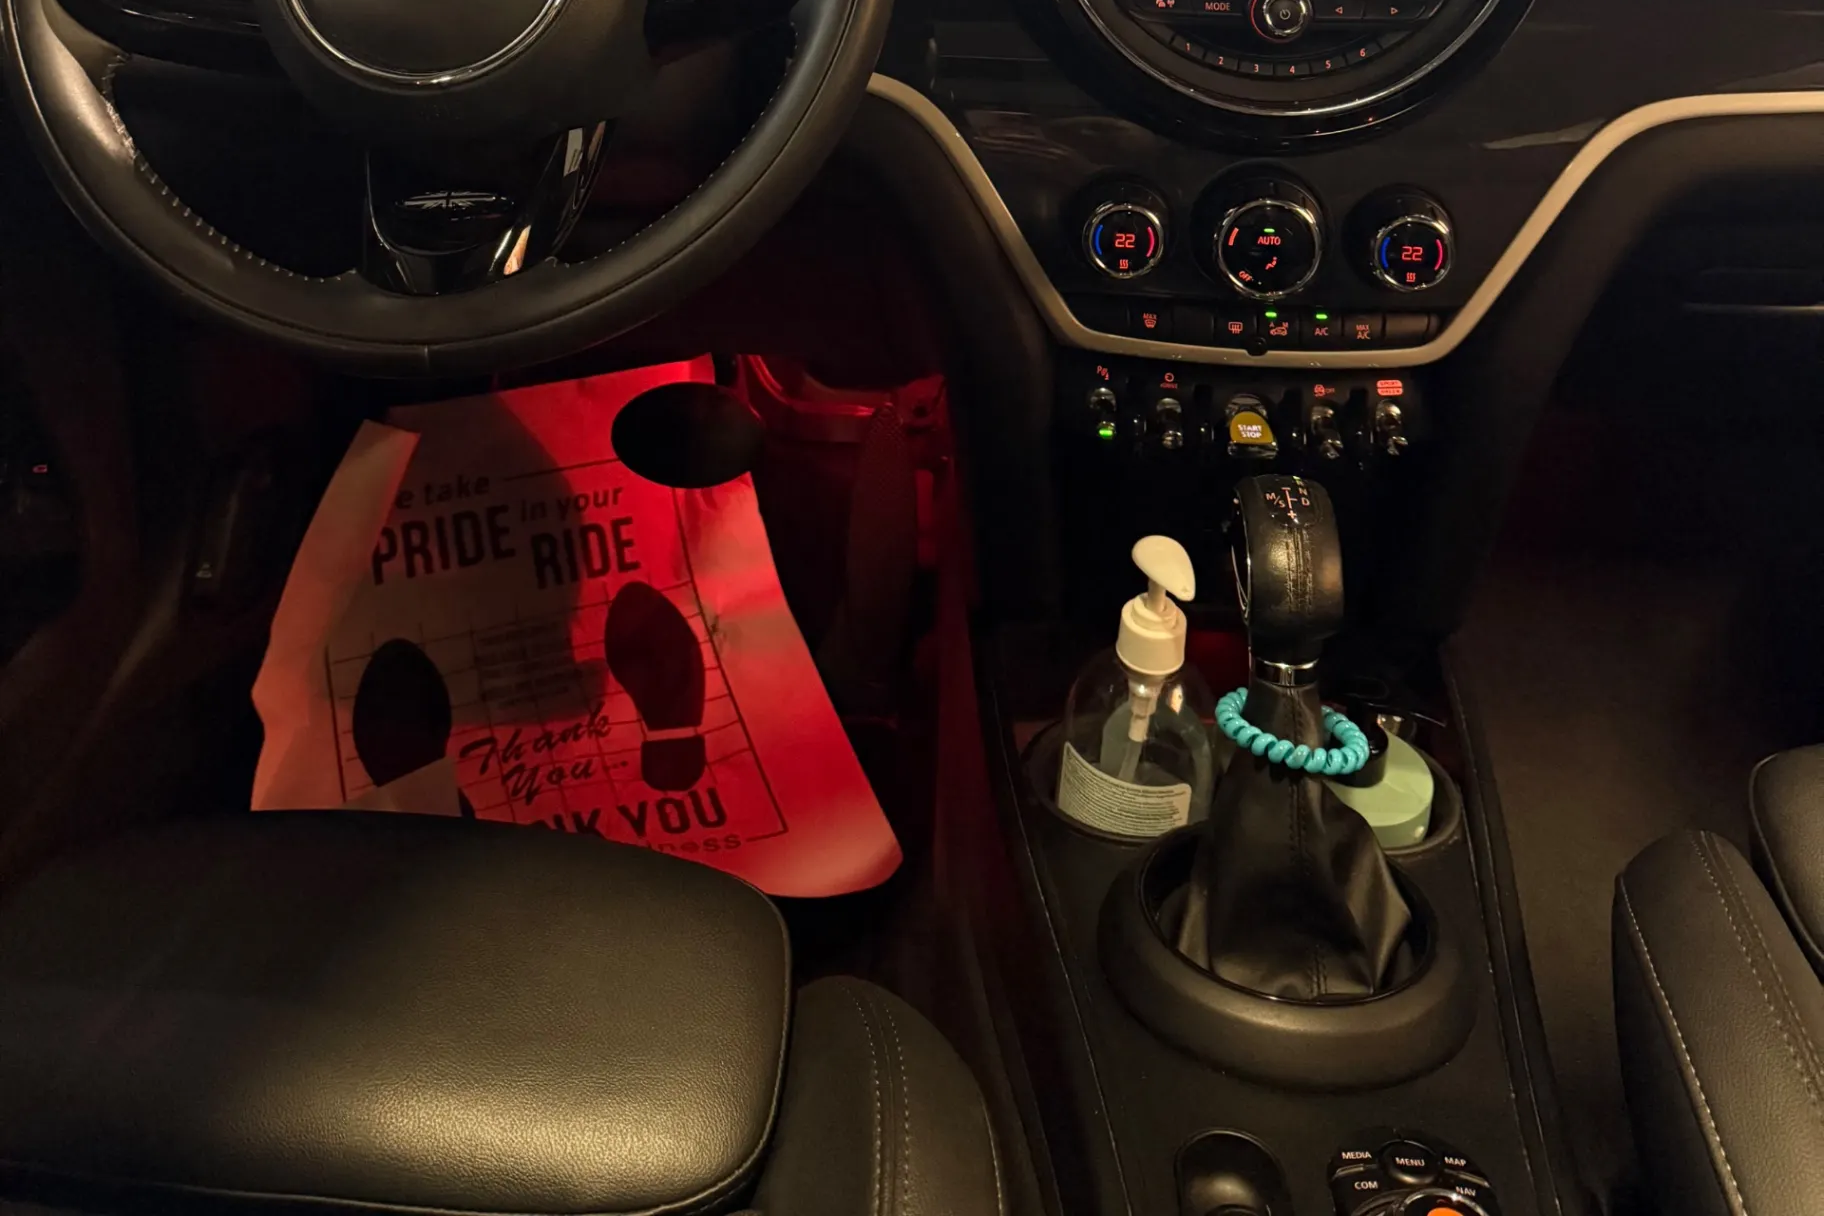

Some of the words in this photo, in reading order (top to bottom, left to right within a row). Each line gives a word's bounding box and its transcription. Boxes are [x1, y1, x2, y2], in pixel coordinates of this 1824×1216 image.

[1205, 2, 1230, 11] MODE
[1186, 43, 1190, 51] 1
[1360, 48, 1366, 57] 6
[1218, 56, 1224, 65] 2
[1325, 60, 1331, 69] 5
[1253, 64, 1259, 72] 3
[1289, 65, 1295, 74] 4
[1114, 234, 1135, 248] 22
[1257, 236, 1281, 245] AUTO
[1402, 247, 1423, 261] 22
[1239, 271, 1253, 282] OFF
[1314, 327, 1329, 336] A/C
[1357, 331, 1371, 339] A/C
[424, 474, 490, 506] take
[521, 499, 548, 522] in
[556, 486, 625, 521] your
[1266, 492, 1285, 508] M/S
[1302, 497, 1310, 506] D
[372, 505, 516, 586] PRIDE
[531, 516, 641, 589] RIDE
[459, 702, 613, 776] Thank
[616, 787, 727, 838] YOU
[1341, 1151, 1372, 1160] MEDIA
[1395, 1157, 1425, 1167] MENU
[1444, 1156, 1467, 1167] MAP
[1354, 1181, 1378, 1190] COM
[1456, 1186, 1476, 1197] NAV
